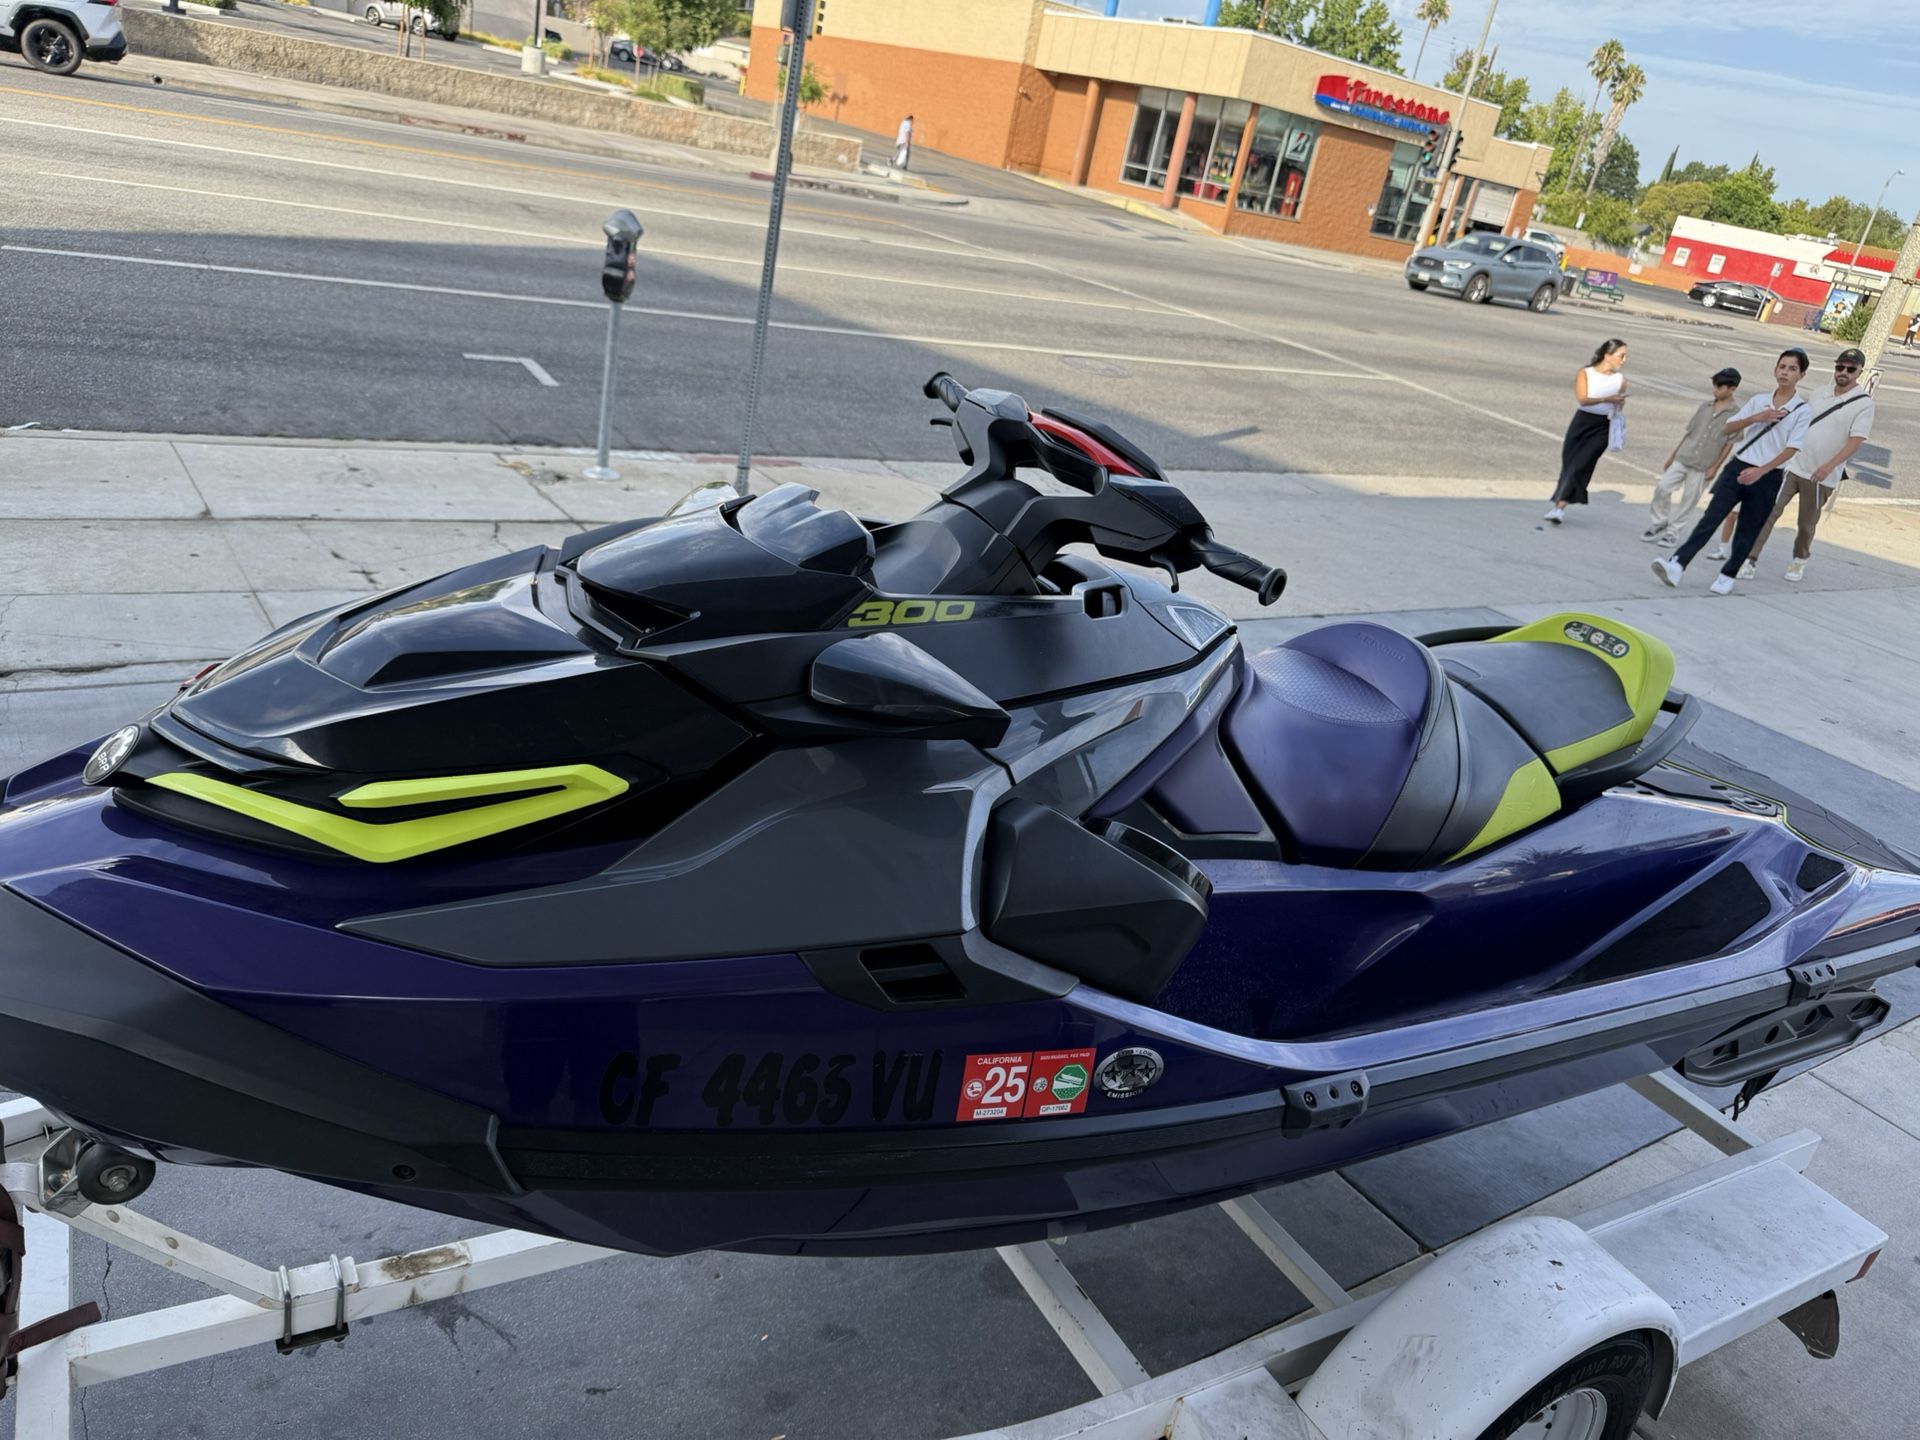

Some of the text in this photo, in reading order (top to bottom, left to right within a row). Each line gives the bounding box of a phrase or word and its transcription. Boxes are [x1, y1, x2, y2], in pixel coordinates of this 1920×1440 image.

[1346, 80, 1450, 125] Firestone
[848, 600, 976, 628] 300
[97, 751, 110, 771] BRP
[977, 1055, 1022, 1066] CALIFORNIA
[600, 1050, 945, 1127] CF 4465 VU
[981, 1066, 1028, 1105] 25
